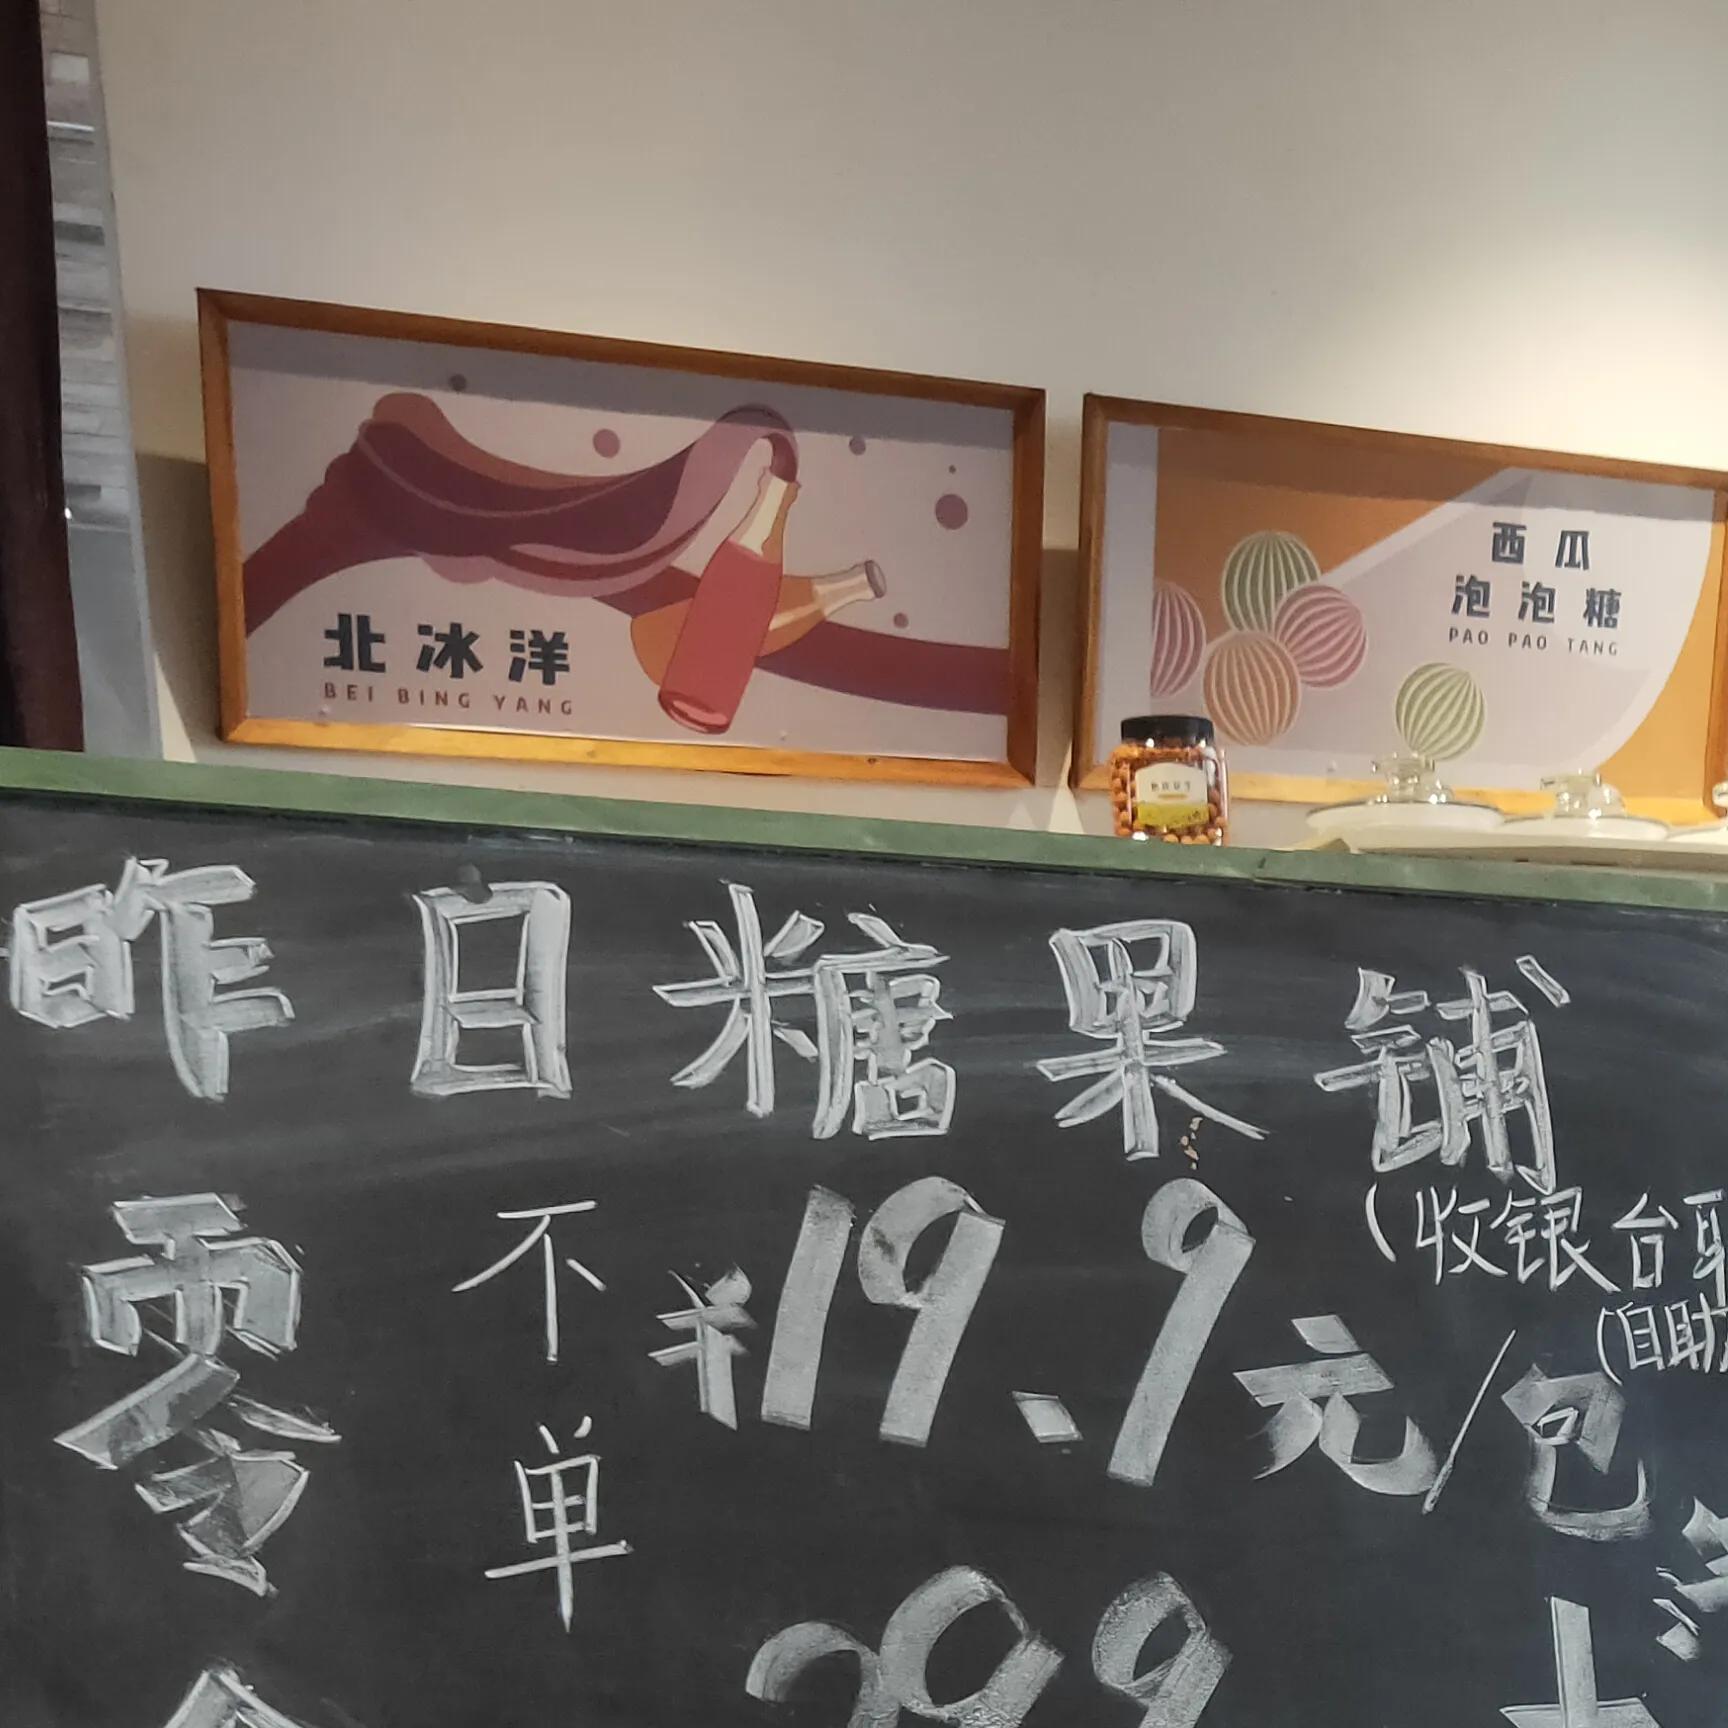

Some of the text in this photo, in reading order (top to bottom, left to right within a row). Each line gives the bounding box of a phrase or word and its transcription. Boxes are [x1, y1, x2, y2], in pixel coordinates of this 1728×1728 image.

[1491, 521, 1590, 571] 西瓜
[1451, 574, 1621, 628] 泡泡糖
[324, 613, 570, 686] 北冰洋
[1449, 627, 1618, 656] PAO PAO TANG
[324, 682, 572, 715] BEI BING YANG
[2, 854, 1570, 1193] 昨日糖果铺
